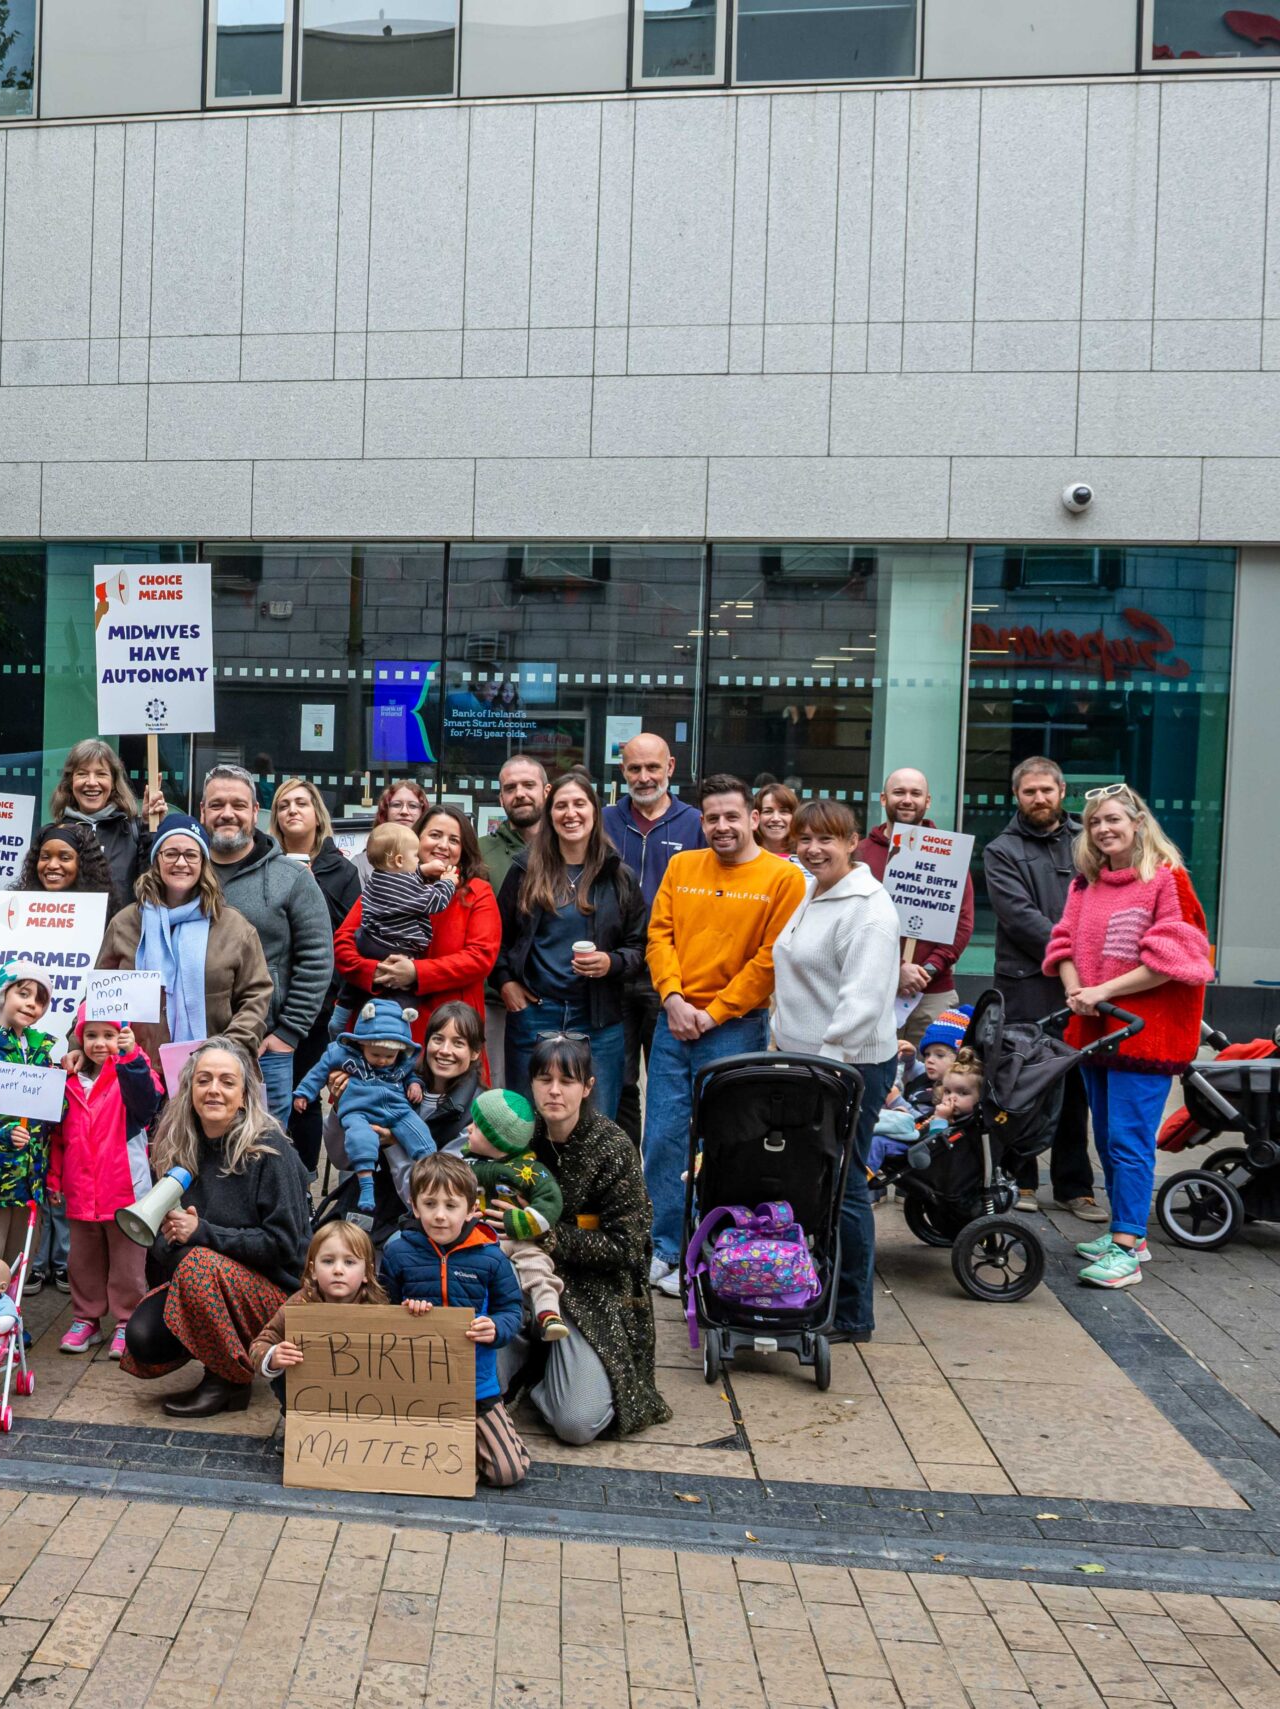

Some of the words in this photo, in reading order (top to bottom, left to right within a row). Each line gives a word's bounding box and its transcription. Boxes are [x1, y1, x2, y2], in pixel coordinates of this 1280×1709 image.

[138, 575, 183, 585] CHOICE
[138, 590, 183, 600] MEANS
[108, 624, 201, 640] MIDWIVES
[129, 646, 180, 661] HAVE
[102, 667, 209, 683] AUTONOMY
[452, 709, 475, 718] Bank
[477, 708, 486, 718] of
[487, 709, 527, 718] Ireland's
[443, 719, 471, 727] Smart
[472, 719, 497, 728] Start
[498, 720, 537, 728] Account
[450, 729, 464, 737] for
[465, 729, 483, 737] 7-15
[484, 731, 504, 740] year
[922, 835, 953, 846] CHOICE
[920, 845, 952, 856] MEANS
[915, 861, 936, 872] HSE
[889, 869, 922, 882] HOME
[926, 875, 958, 888] BIRTH
[676, 886, 713, 896] TOMMY
[726, 891, 771, 903] HILFIGER
[895, 882, 952, 899] MIDWIVES
[28, 902, 75, 913] CHOICE
[26, 917, 74, 928] MEANS
[22, 1085, 42, 1095] BABY
[294, 1385, 460, 1428] CHOICE
[296, 1430, 463, 1475] MATTERS
